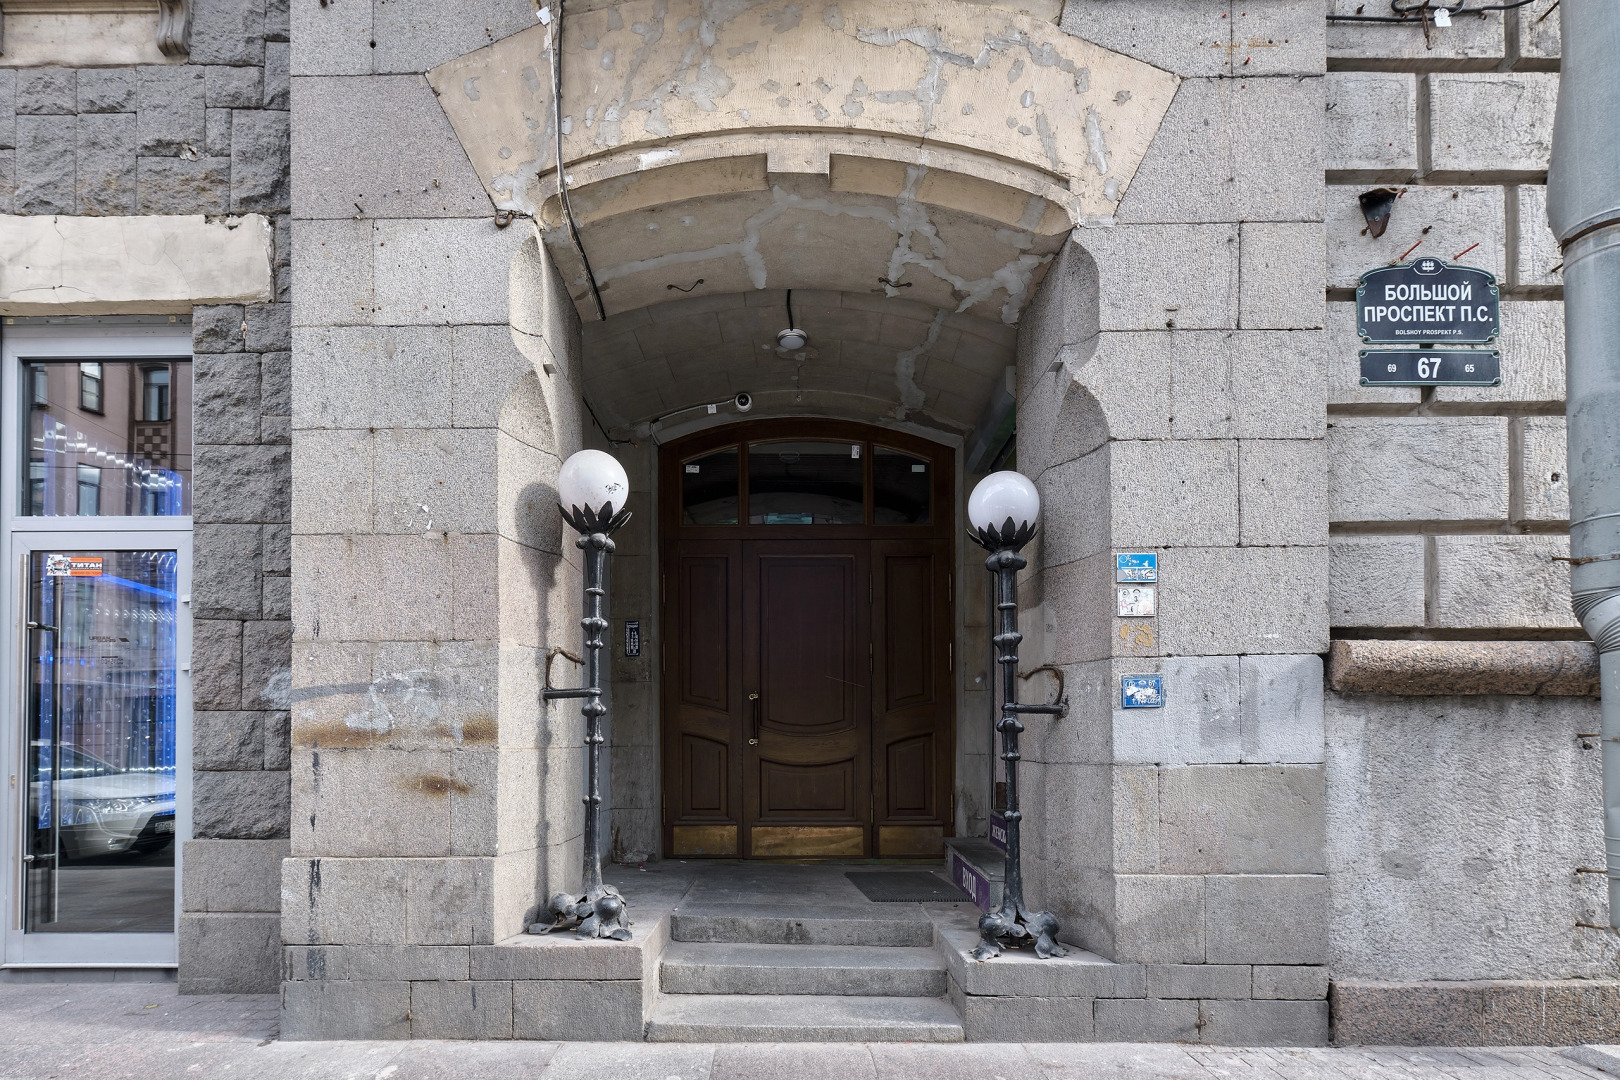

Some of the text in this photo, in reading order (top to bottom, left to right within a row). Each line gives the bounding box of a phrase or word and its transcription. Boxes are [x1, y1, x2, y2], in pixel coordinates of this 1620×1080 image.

[1385, 281, 1472, 300] БОЛЬШОЙ
[1364, 305, 1493, 322] ПРОСПЕКТ П.С.
[1387, 363, 1397, 373] 69
[1417, 357, 1442, 379] 67
[1464, 363, 1475, 373] 65
[963, 866, 976, 902] ВХОД
